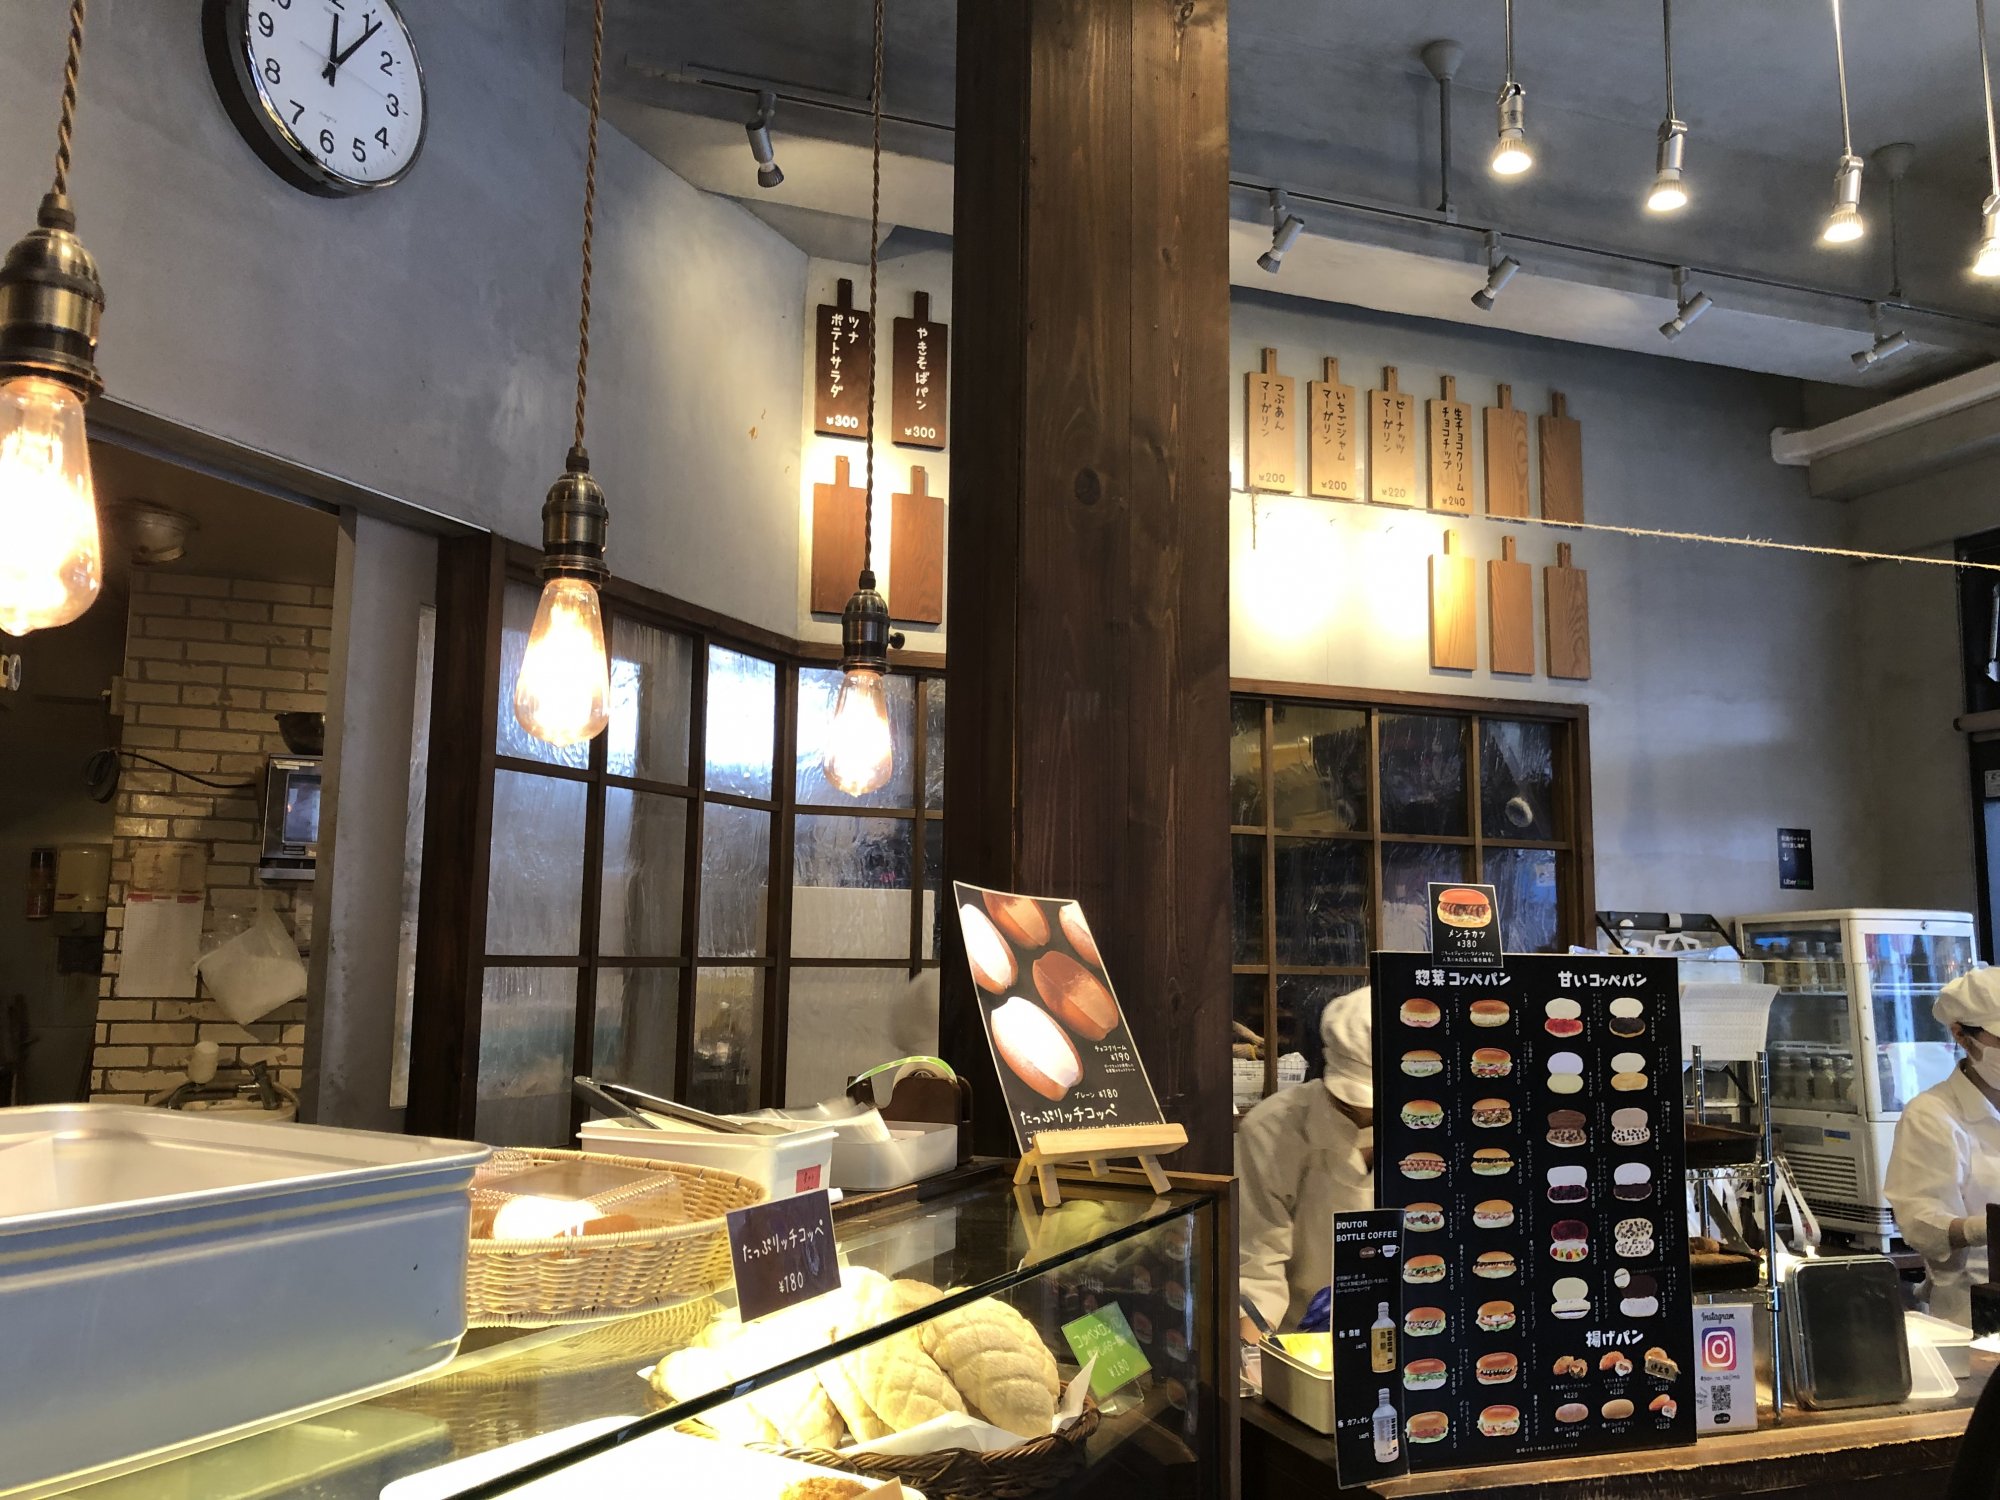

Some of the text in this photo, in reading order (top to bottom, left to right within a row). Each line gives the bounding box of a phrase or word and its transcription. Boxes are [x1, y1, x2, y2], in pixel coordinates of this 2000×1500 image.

[258, 11, 274, 38] 9
[265, 57, 281, 85] 8
[379, 51, 393, 77] 2
[290, 99, 305, 125] 7
[385, 93, 400, 118] 3
[319, 129, 335, 154] 6
[352, 137, 367, 163] 5
[374, 126, 390, 150] 4
[848, 316, 860, 344] ツナ
[830, 313, 844, 398] ポテトサラダ
[916, 327, 930, 410] やきそばパン
[1261, 381, 1272, 437] マーガリン
[1274, 384, 1285, 431] つぶあん
[1323, 389, 1334, 445] マーガリン
[826, 415, 859, 429] ¥300
[904, 426, 936, 439] ¥300
[1335, 391, 1347, 462] いちごジャム
[1383, 398, 1393, 453] マーガリン
[1396, 400, 1406, 454] ピーナッツ
[1442, 406, 1452, 471] チョコチップ
[1454, 407, 1464, 492] 生チョコクリーム
[1258, 472, 1285, 484] ¥200
[1321, 479, 1347, 491] ¥200
[1442, 496, 1466, 507] ¥240
[1448, 929, 1486, 939] メンチカツ
[1457, 940, 1477, 948] ¥380
[1558, 970, 1647, 988] 甘いコッペパン
[1094, 1044, 1127, 1053] チョコクリーム
[1110, 1052, 1130, 1061] ¥190
[1074, 1088, 1119, 1100] プレーン ¥180
[1336, 1221, 1368, 1230] DOUTOR
[1336, 1231, 1398, 1242] BOTTLE COFFEE
[779, 1271, 804, 1294] ¥180
[1701, 1312, 1735, 1324] Instagram
[1585, 1329, 1644, 1348] 揚げパン
